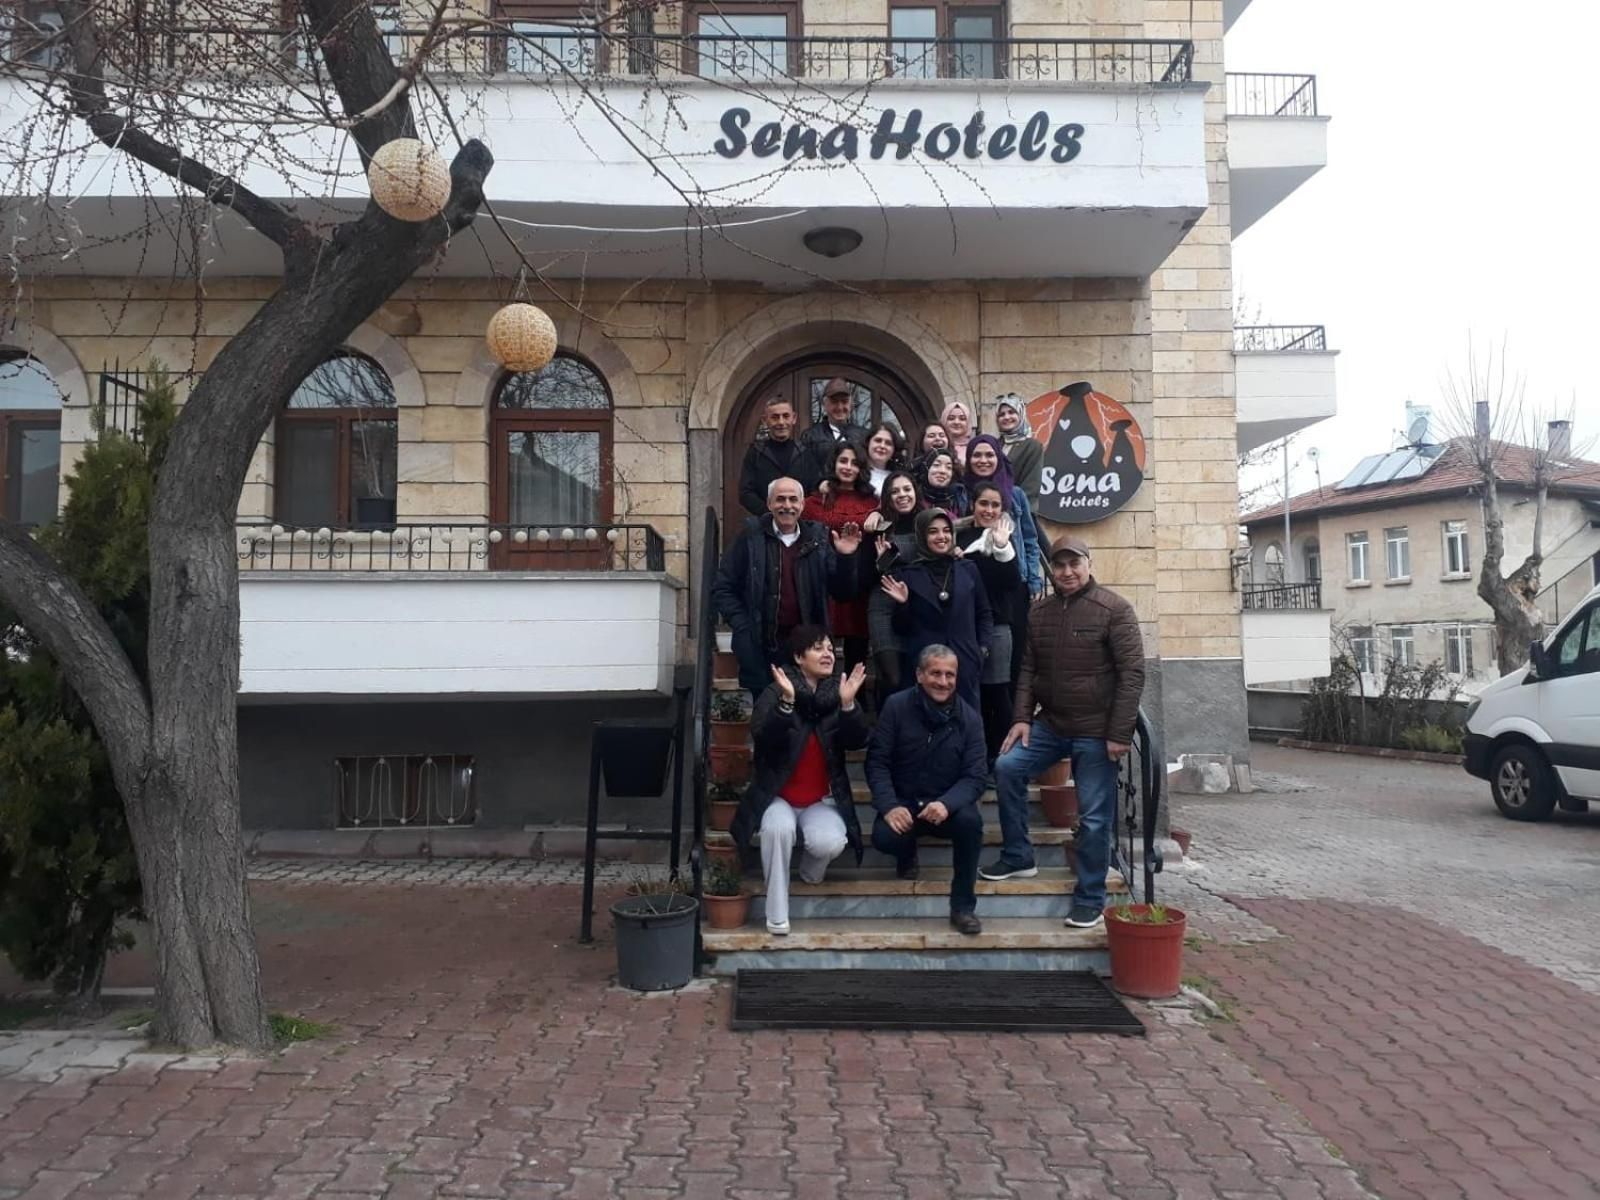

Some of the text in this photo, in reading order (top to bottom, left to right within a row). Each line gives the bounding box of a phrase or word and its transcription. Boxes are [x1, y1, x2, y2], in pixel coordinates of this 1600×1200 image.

[714, 107, 1085, 163] Sena Hotels
[1040, 466, 1121, 495] Sena
[1059, 495, 1110, 508] Hotels
